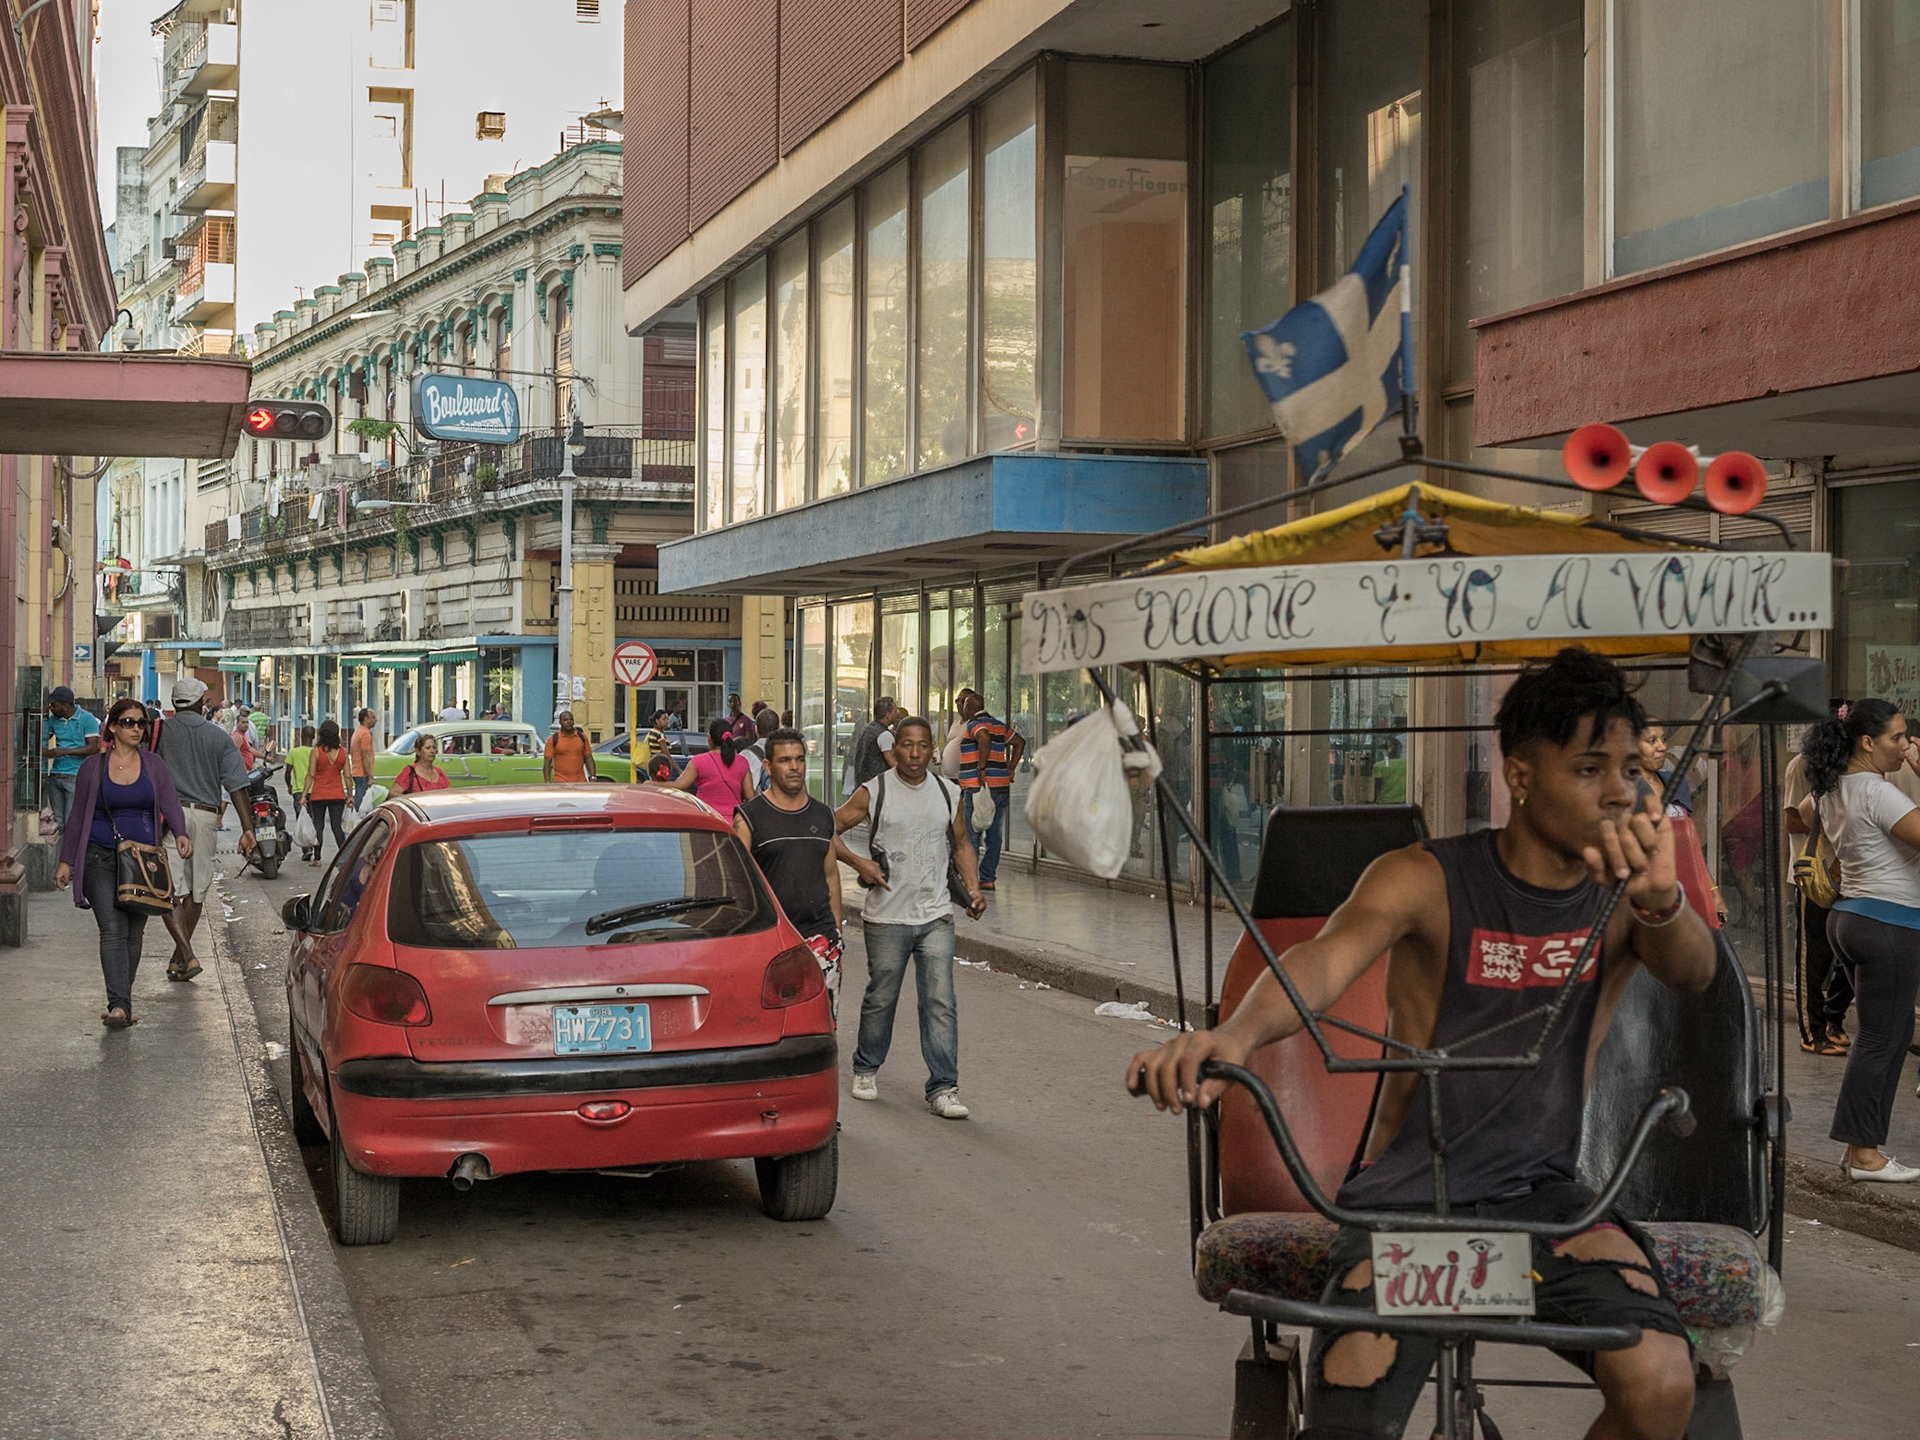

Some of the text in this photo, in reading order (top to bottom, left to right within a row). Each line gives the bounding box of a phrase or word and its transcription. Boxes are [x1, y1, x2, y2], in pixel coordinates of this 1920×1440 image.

[426, 384, 502, 425] Boulevard
[625, 658, 642, 666] PARE
[1480, 939, 1528, 959] RESET
[589, 1006, 613, 1017] CUBA
[556, 1015, 646, 1044] HWZ731
[600, 1042, 607, 1052] 3
